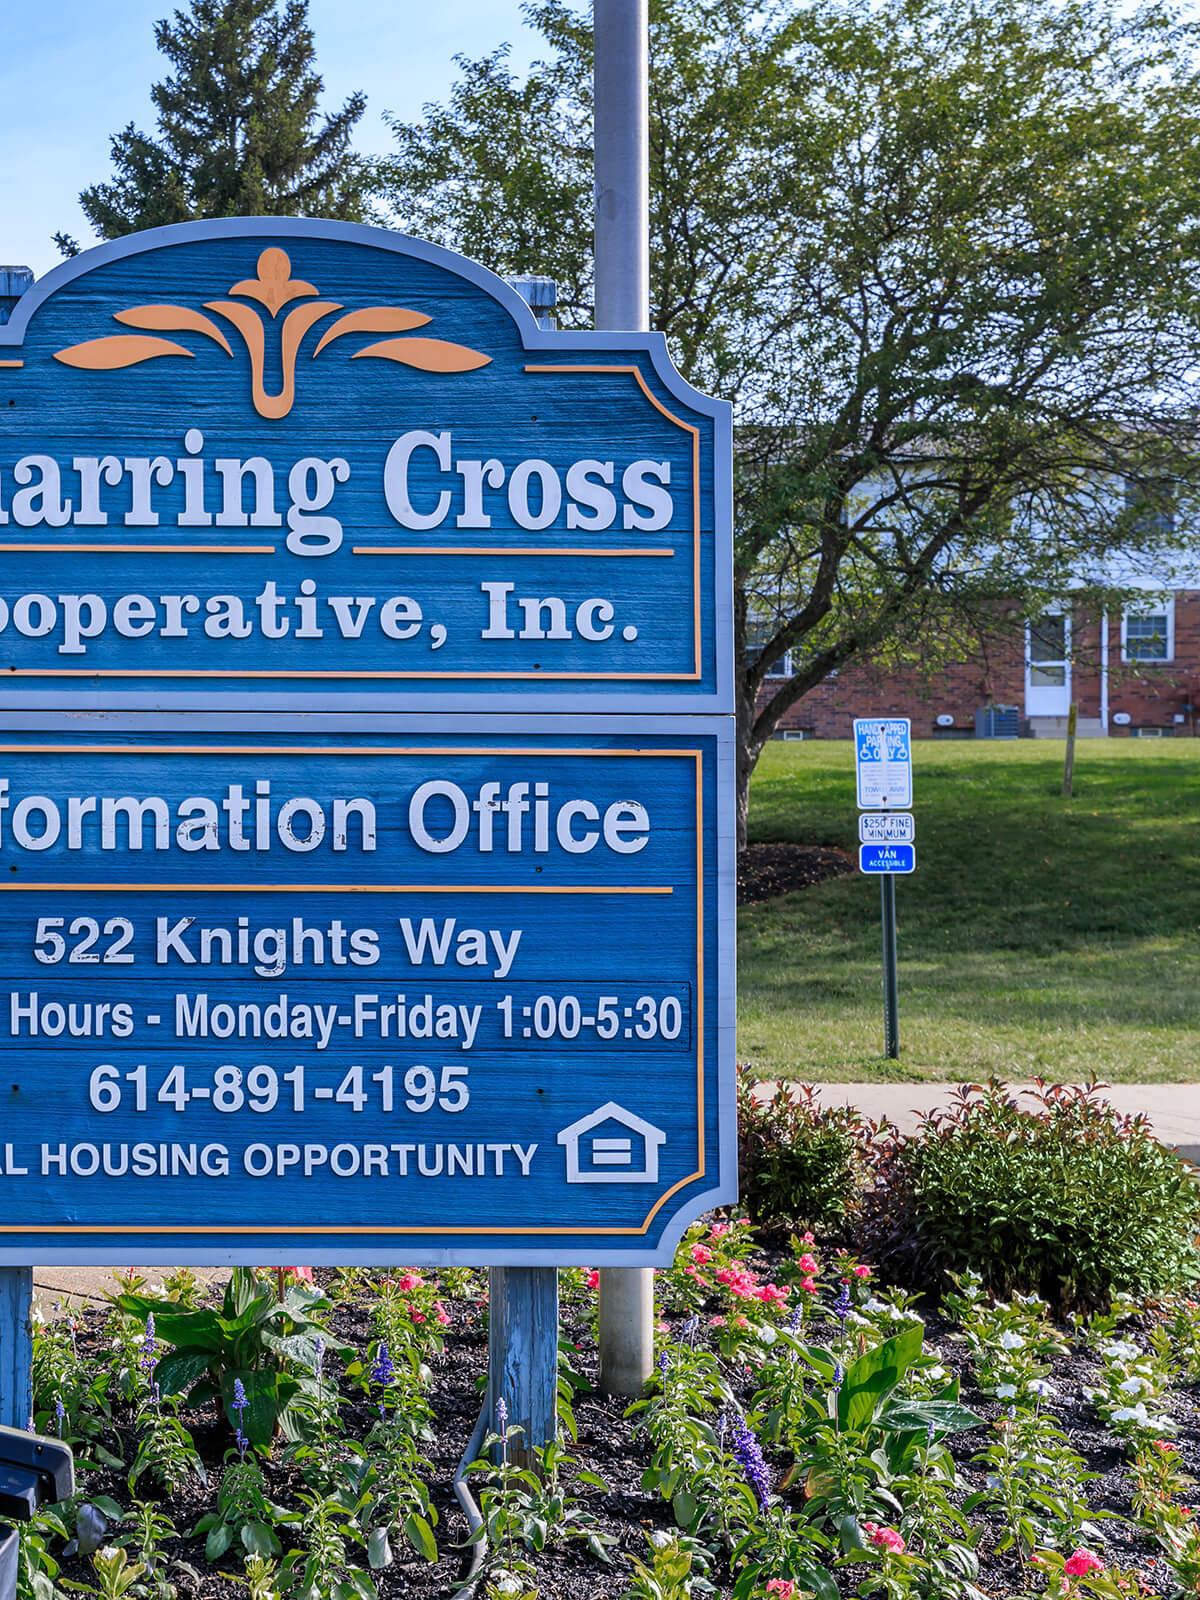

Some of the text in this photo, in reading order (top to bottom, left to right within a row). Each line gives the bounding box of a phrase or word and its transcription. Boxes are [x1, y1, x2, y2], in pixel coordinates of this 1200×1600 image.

[384, 430, 673, 531] Cross
[481, 582, 637, 641] Inc.
[858, 723, 906, 735] HANDAPPED
[866, 736, 900, 747] PARING
[874, 748, 895, 760] OLY
[409, 780, 650, 854] Office
[864, 818, 910, 828] $250 FINE
[868, 829, 906, 838] MINIMUM
[868, 859, 907, 867] ACCESSIBLE
[877, 850, 897, 859] VAN
[34, 916, 522, 978] 522 Knights Way
[11, 992, 134, 1037] Hours
[147, 1015, 160, 1024] -
[176, 994, 482, 1049] Monday-Friday
[497, 995, 682, 1039] 1:00-5:30
[90, 1065, 469, 1112] 614-891-4195
[41, 1143, 229, 1176] HOUSING
[244, 1143, 538, 1177] OPPORTUNITY
